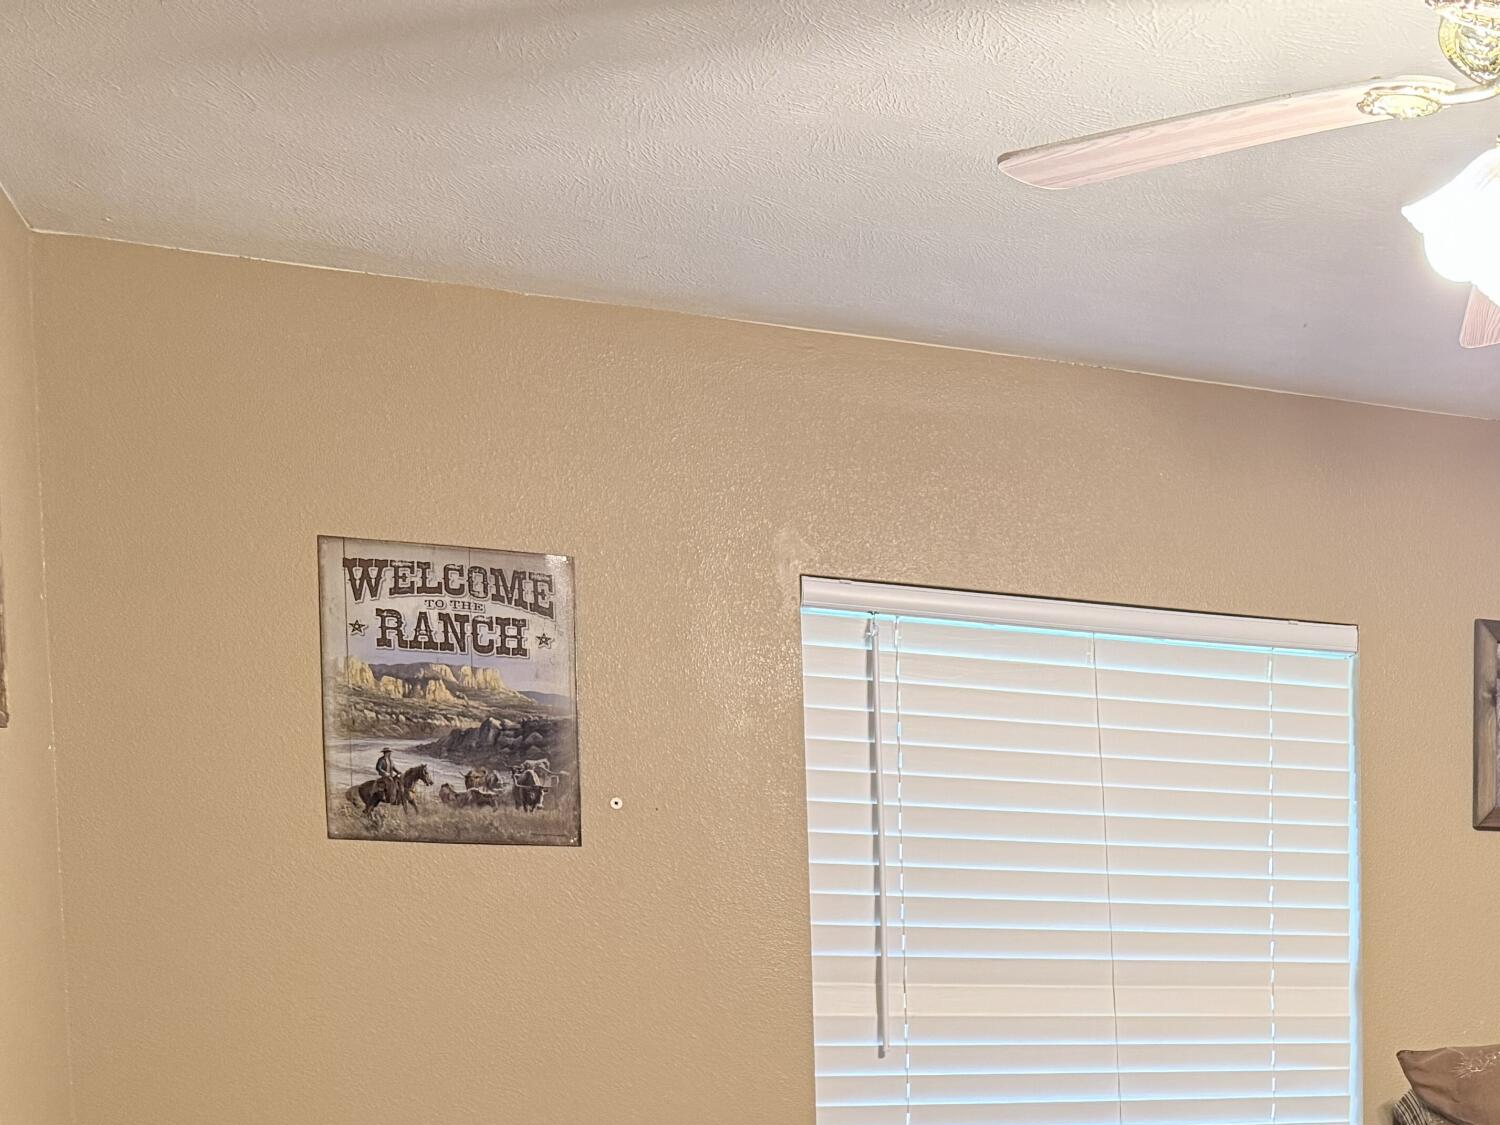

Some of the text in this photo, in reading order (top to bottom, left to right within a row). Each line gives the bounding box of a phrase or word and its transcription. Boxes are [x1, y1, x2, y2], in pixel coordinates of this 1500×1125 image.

[342, 556, 555, 619] WELCOME
[424, 599, 484, 612] TO THE
[375, 607, 527, 658] RANCH
